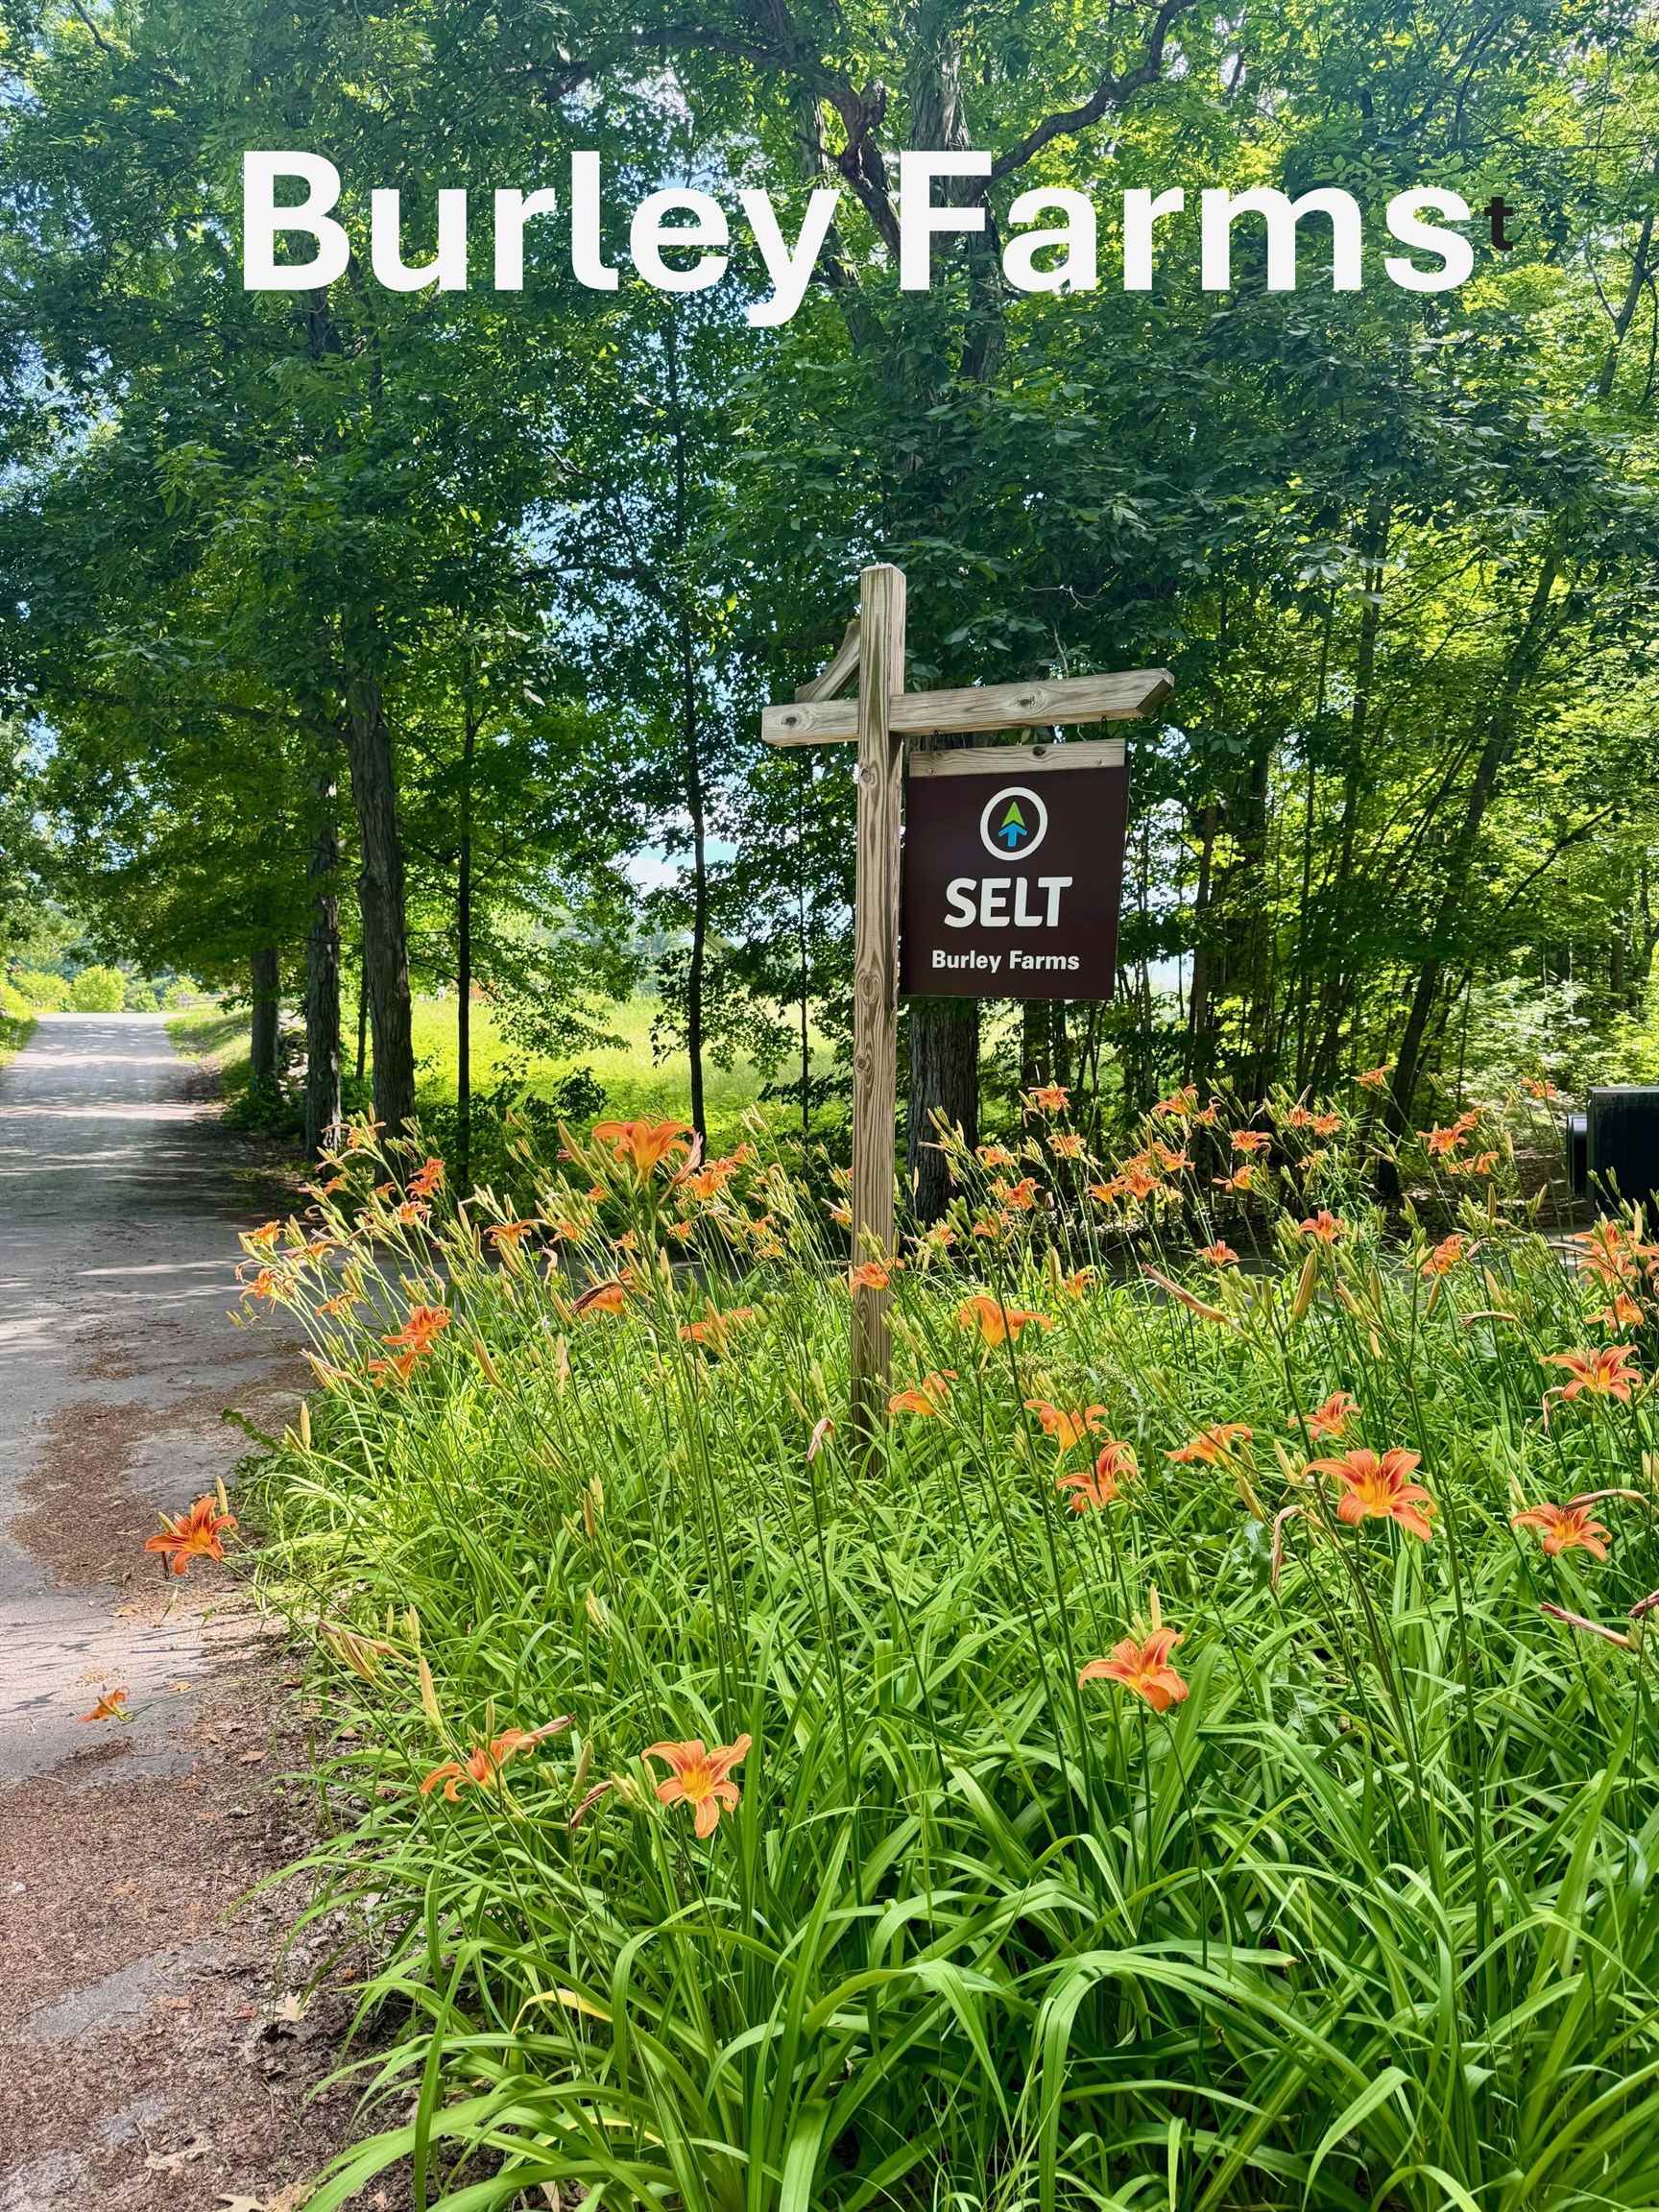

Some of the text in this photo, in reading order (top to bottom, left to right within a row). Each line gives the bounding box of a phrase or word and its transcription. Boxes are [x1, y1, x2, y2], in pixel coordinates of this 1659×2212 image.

[944, 876, 1073, 928] SELT
[931, 950, 1081, 974] Burley Farms
